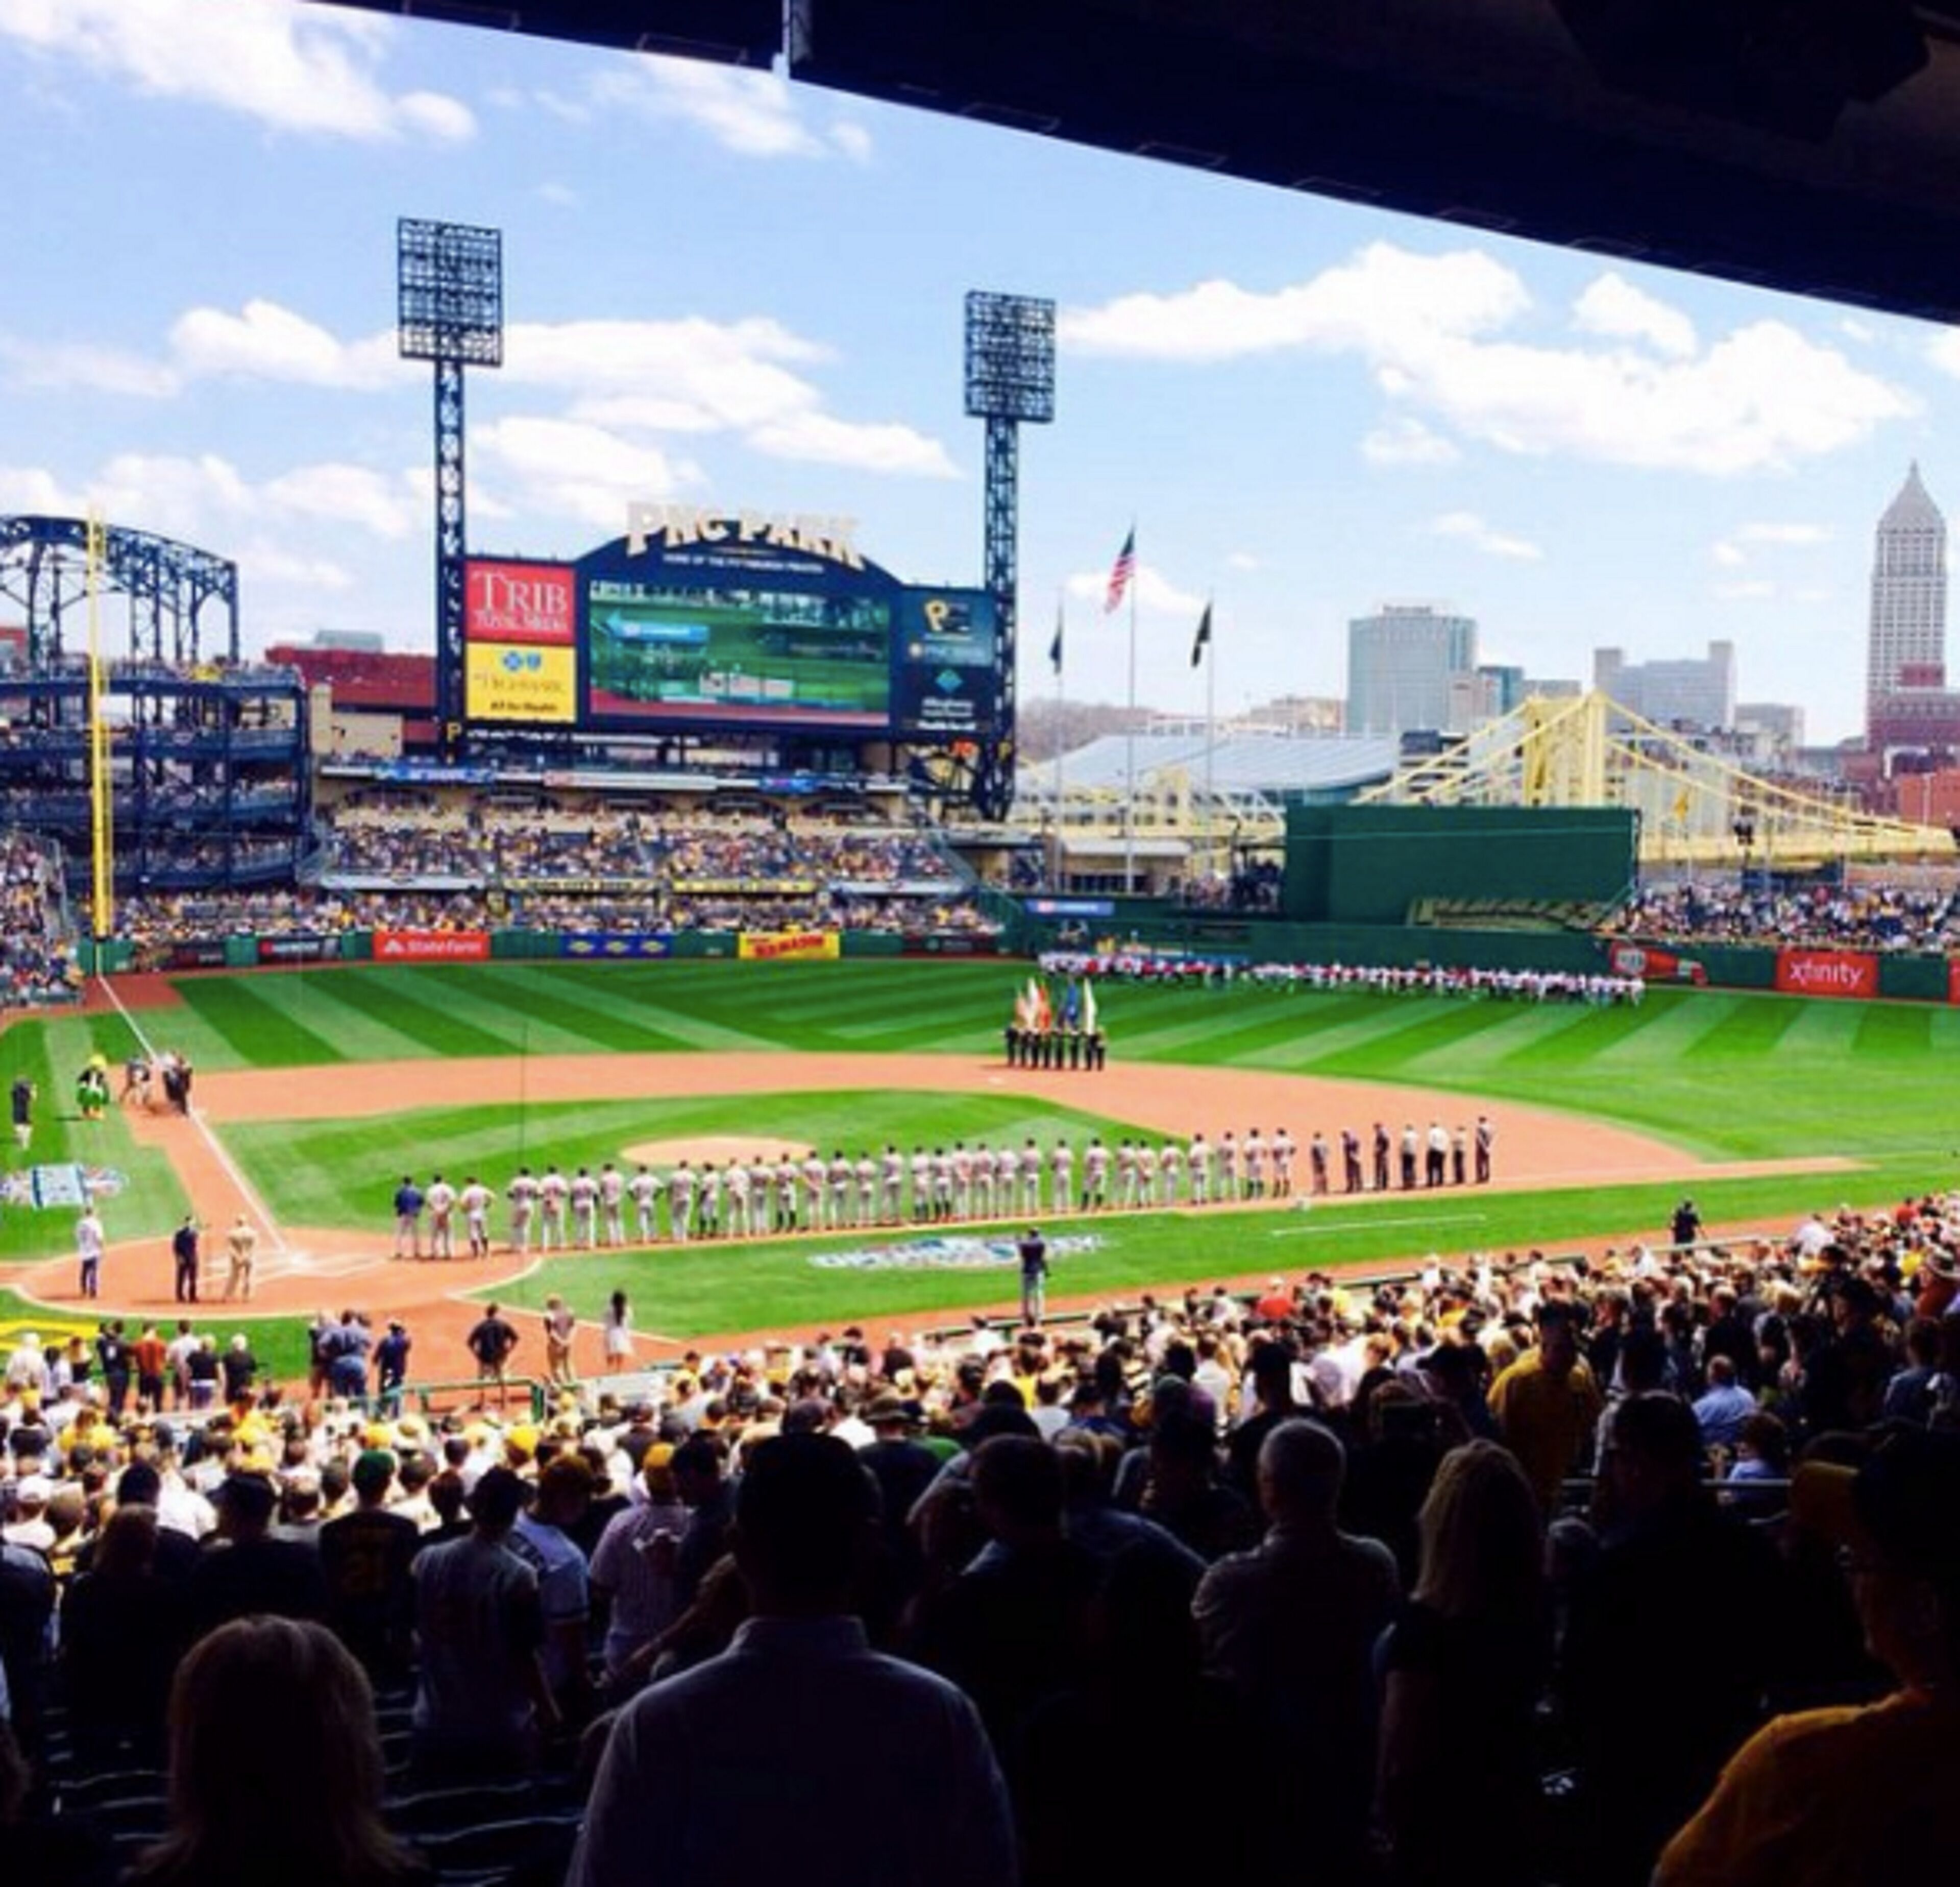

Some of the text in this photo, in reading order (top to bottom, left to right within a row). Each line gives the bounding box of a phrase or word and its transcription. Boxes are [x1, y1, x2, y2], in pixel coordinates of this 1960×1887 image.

[627, 502, 865, 573] PNC PARK
[471, 570, 568, 615] TRIB
[1790, 958, 1865, 989] xfinity
